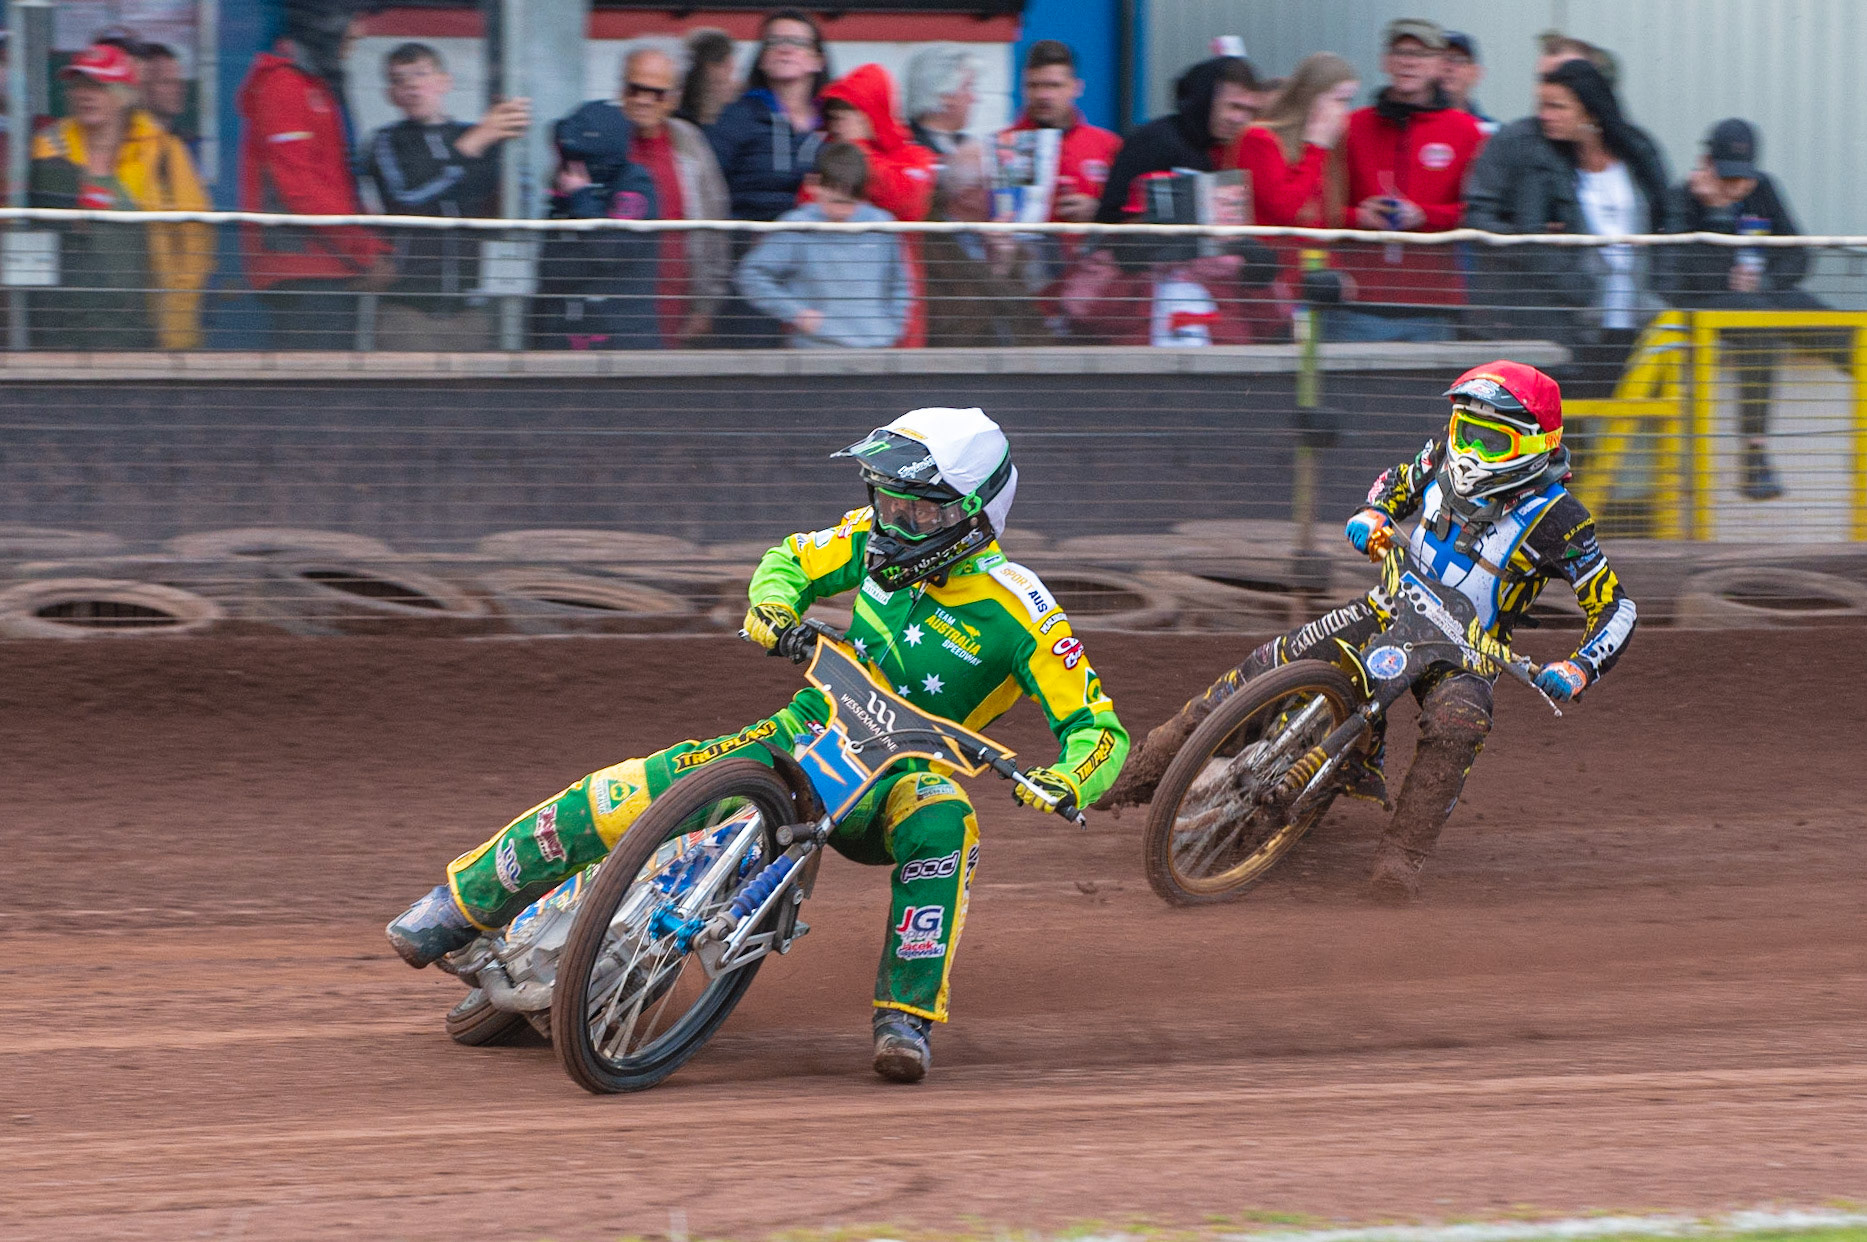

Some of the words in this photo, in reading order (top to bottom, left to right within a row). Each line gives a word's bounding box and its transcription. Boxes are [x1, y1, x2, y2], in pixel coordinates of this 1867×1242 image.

[1000, 568, 1032, 591] SPORT
[1028, 590, 1048, 613] AUS
[934, 608, 956, 625] TEAM
[924, 615, 981, 656] AUSTRALIA
[942, 639, 983, 666] SPEEDWAY
[840, 693, 899, 752] WESSEXMAINE
[897, 908, 942, 932] JG
